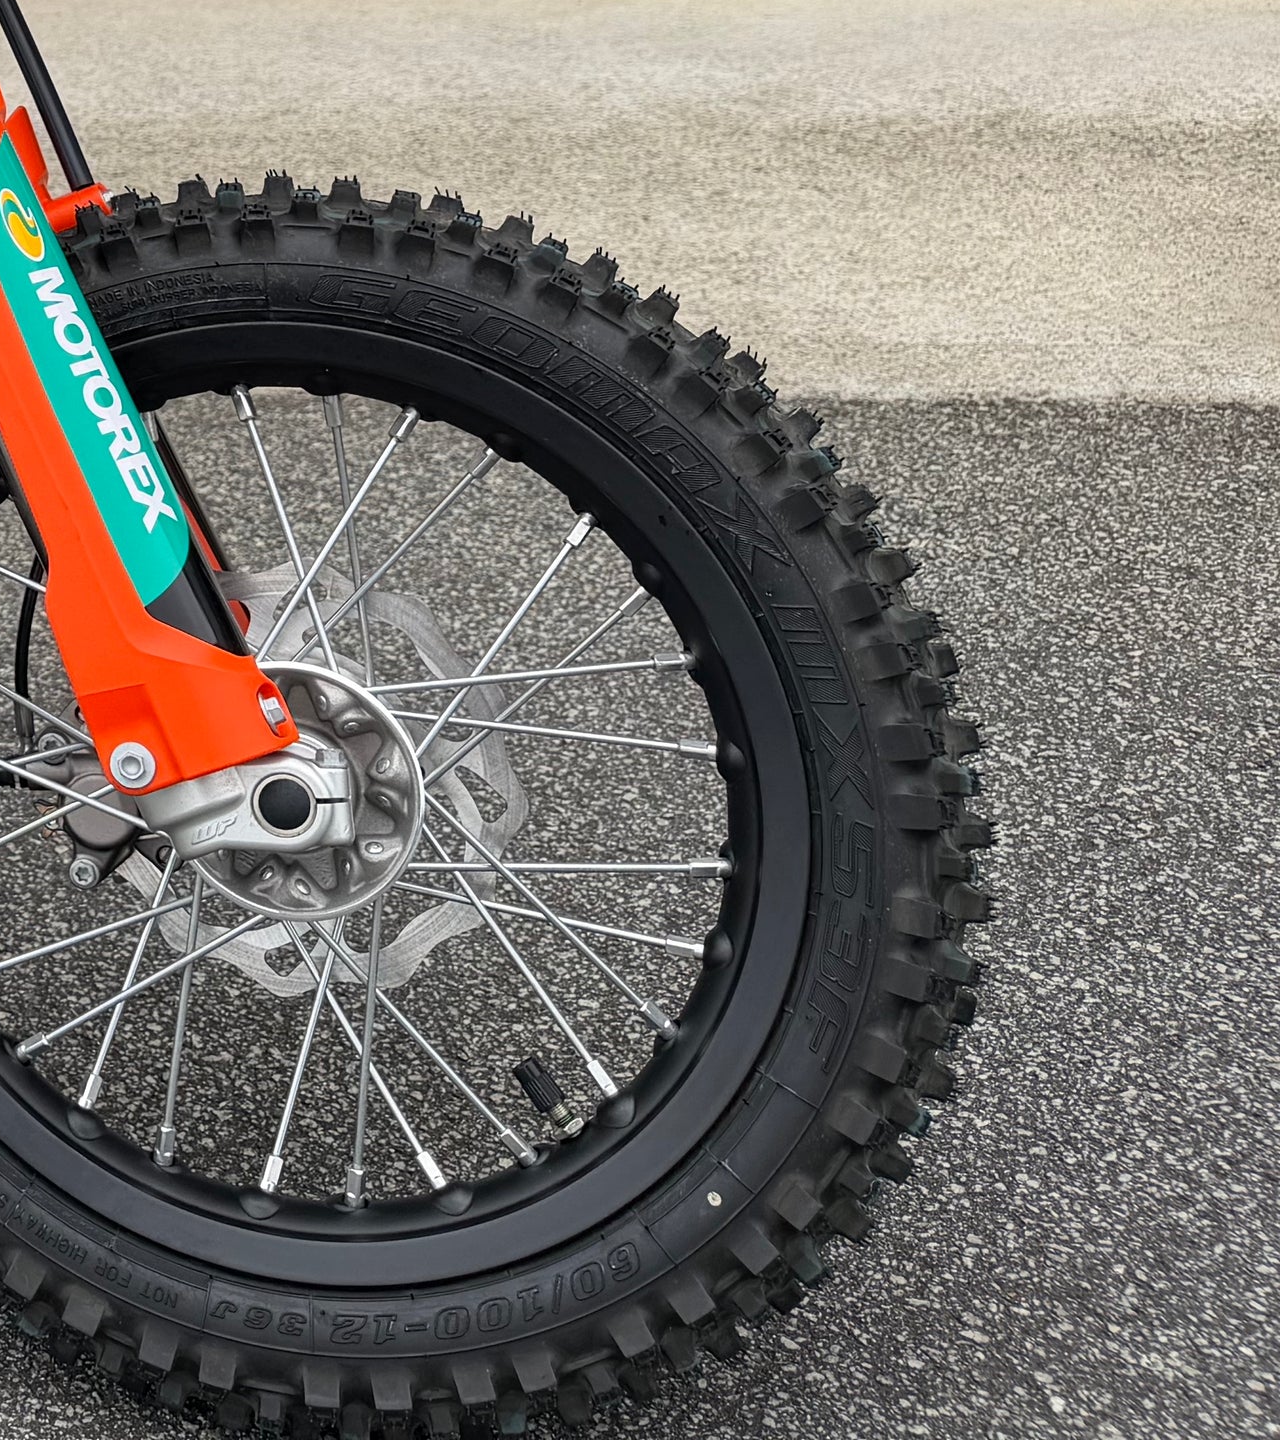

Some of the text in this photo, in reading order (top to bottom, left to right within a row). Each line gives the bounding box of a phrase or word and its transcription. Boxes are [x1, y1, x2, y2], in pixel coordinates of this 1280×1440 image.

[126, 285, 140, 298] IN
[143, 271, 216, 294] INDONESIA
[28, 265, 179, 535] MOTOREX
[309, 273, 793, 574] GEOMAX
[191, 811, 239, 846] WP
[12, 1204, 88, 1265] HIGHWAY
[94, 1257, 133, 1288] FOR
[139, 1281, 178, 1309] NOT
[209, 1239, 642, 1347] 60/100-12 36J
